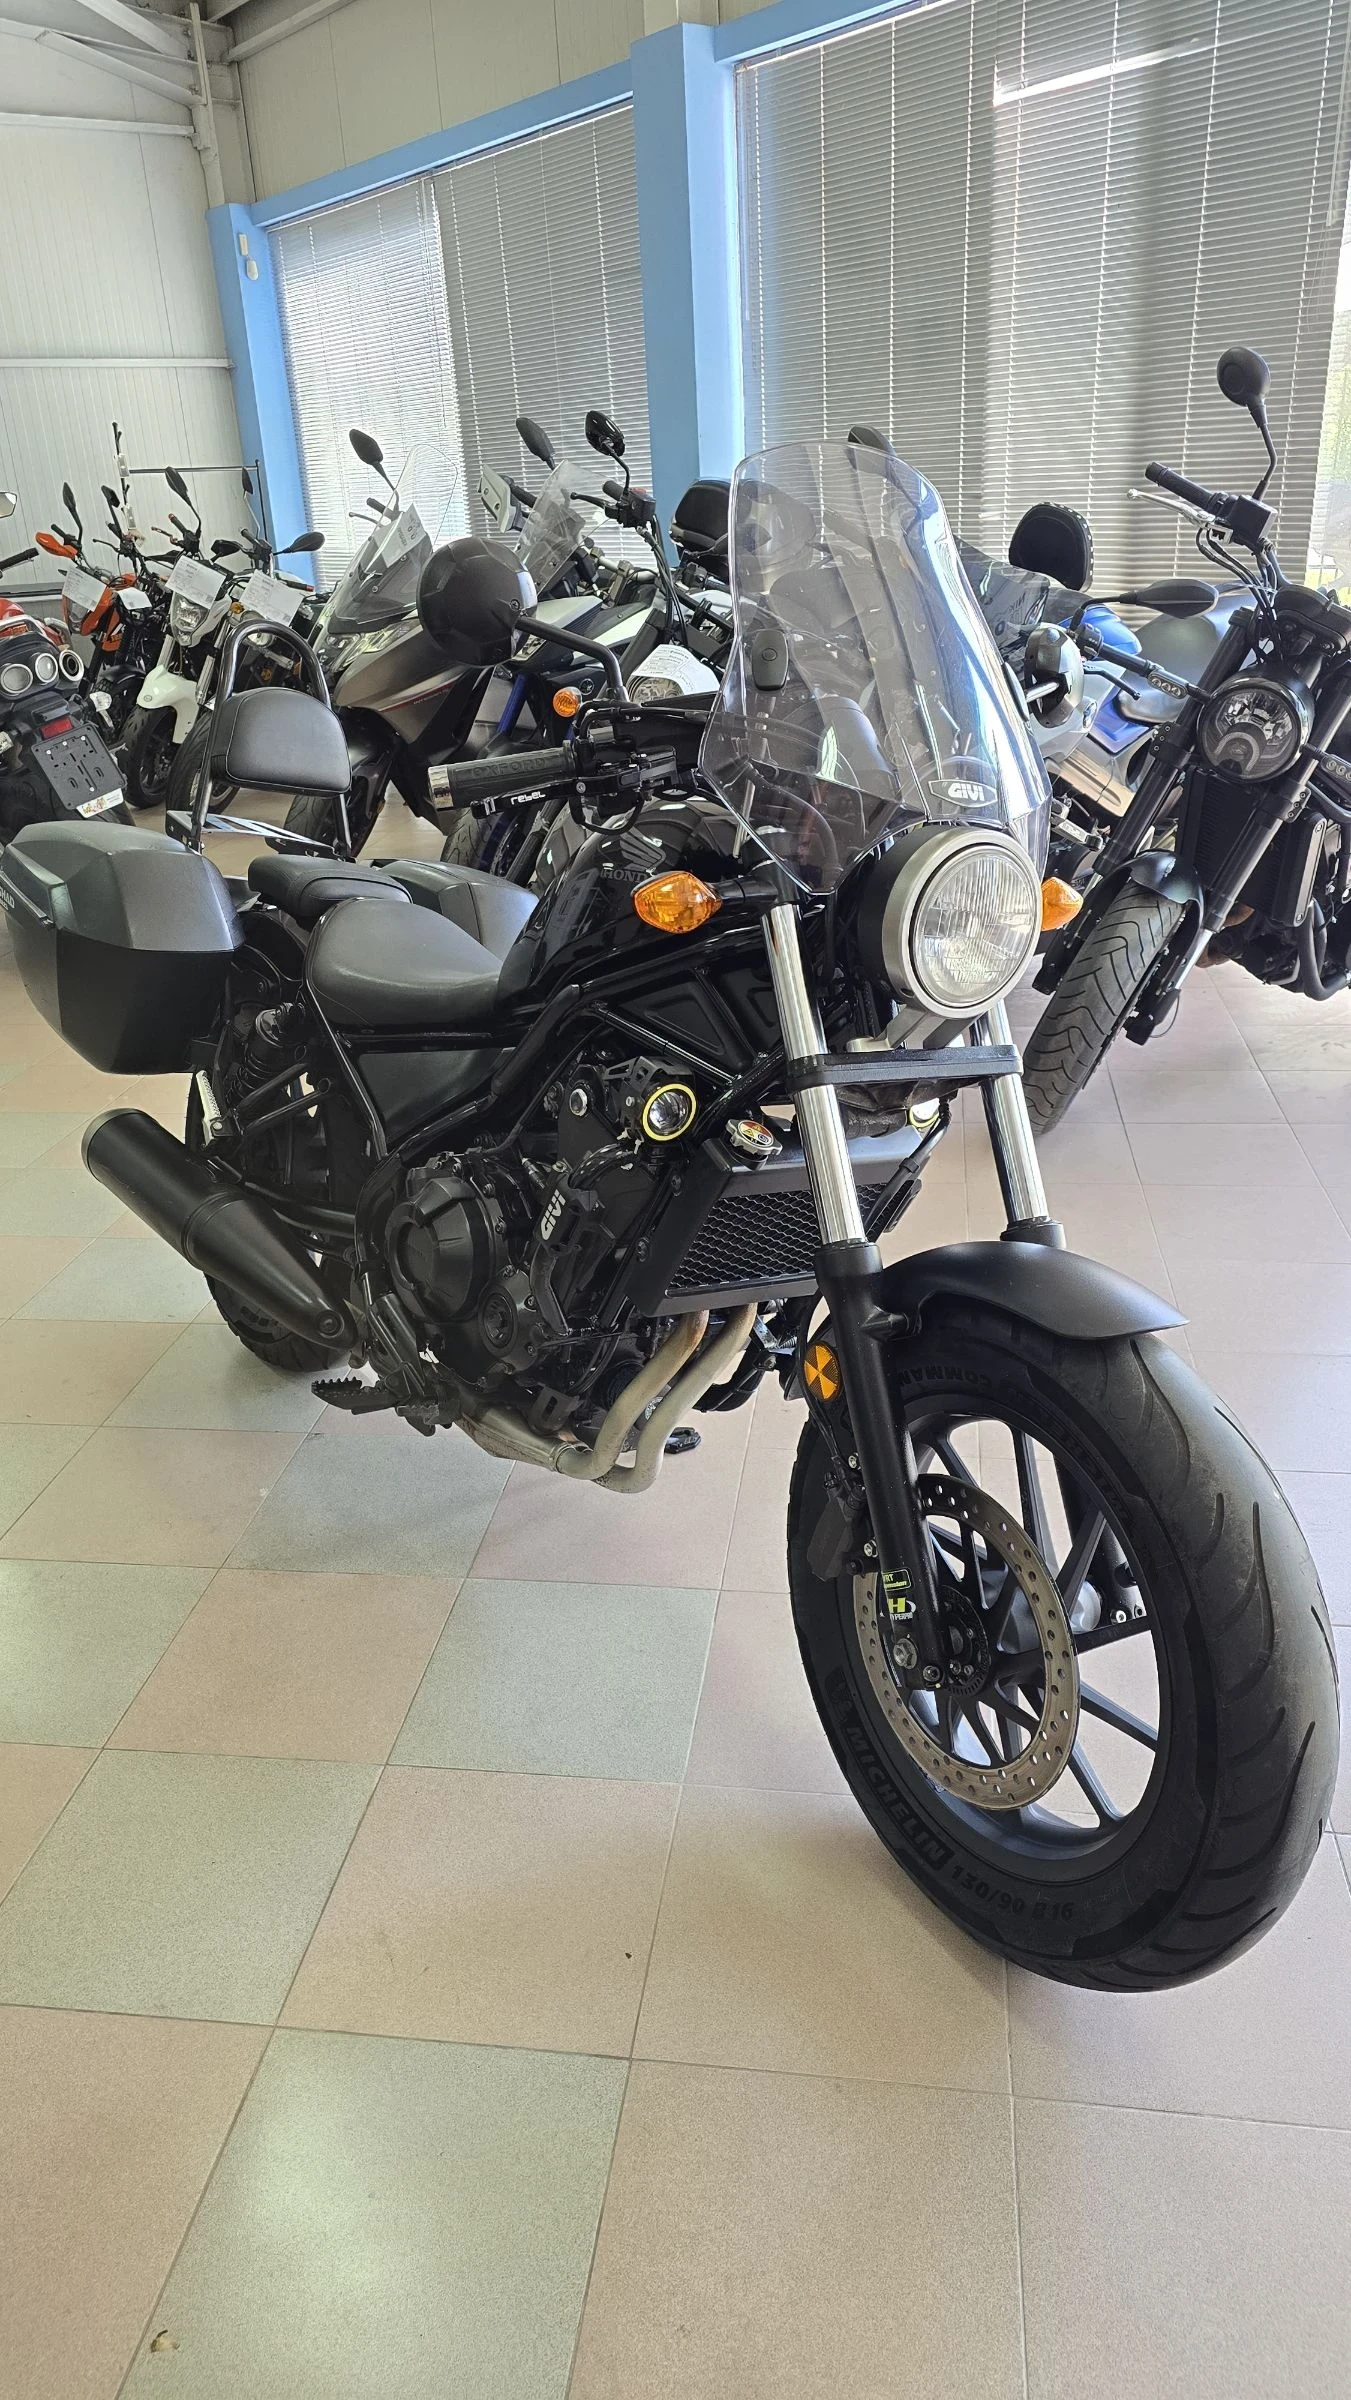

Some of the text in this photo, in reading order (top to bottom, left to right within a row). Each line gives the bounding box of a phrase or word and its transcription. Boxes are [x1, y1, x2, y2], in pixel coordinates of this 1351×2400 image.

[472, 757, 546, 777] OXFORD
[948, 782, 985, 801] GIVI
[600, 867, 649, 884] HOND
[541, 1188, 566, 1241] GIVI
[846, 1726, 950, 1869] MICHELIN
[952, 1864, 1027, 1915] 130/90
